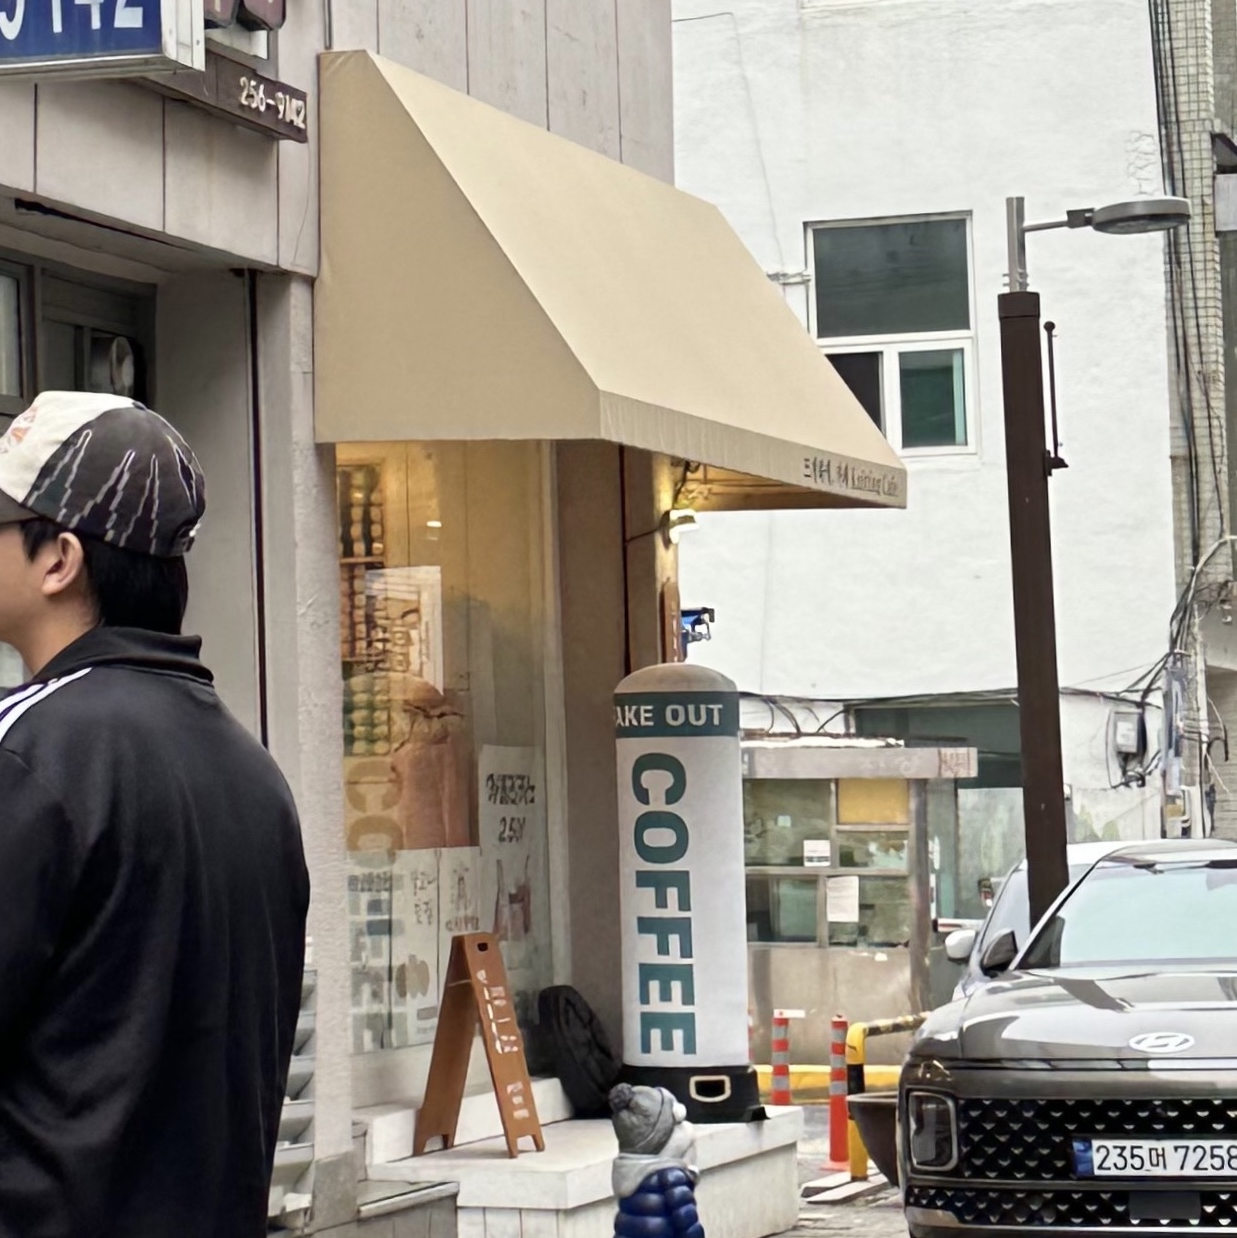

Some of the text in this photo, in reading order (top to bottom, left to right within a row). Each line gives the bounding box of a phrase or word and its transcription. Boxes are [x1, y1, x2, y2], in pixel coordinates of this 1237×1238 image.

[665, 704, 723, 727] OUT
[631, 752, 697, 1055] COFFEE
[1173, 1145, 1237, 1171] 7258
